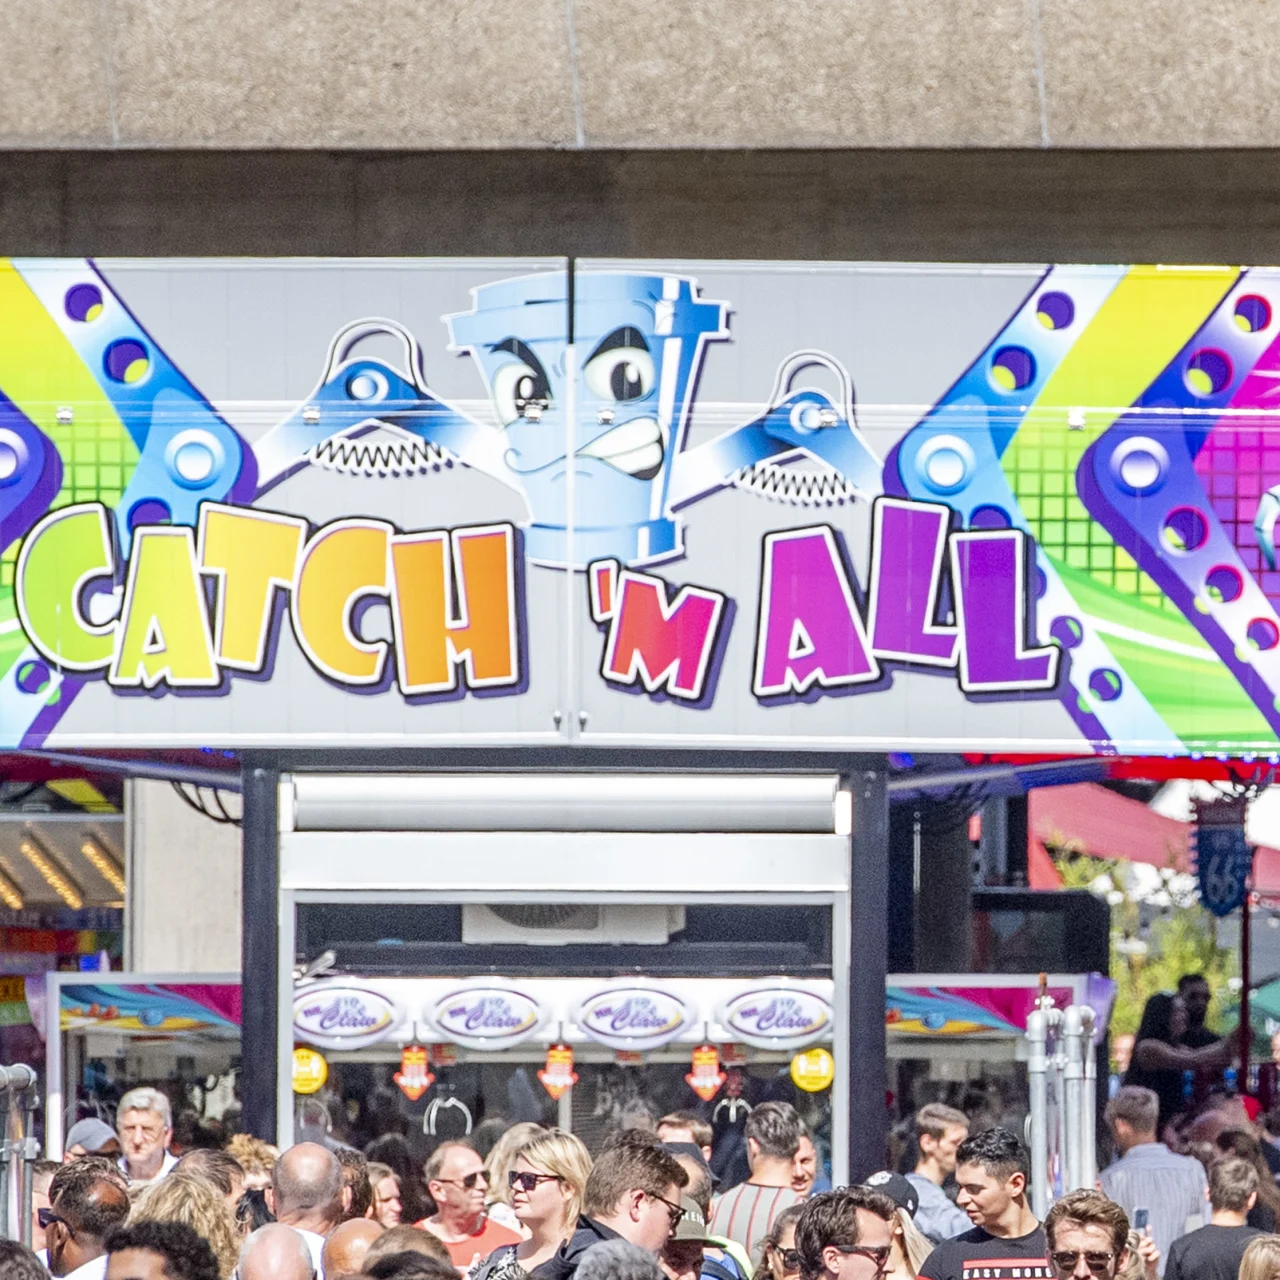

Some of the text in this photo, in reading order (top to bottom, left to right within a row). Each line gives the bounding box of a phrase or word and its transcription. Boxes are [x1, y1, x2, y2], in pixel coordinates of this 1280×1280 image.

[15, 496, 1064, 703] CATCH 'M ALL
[962, 1267, 1001, 1280] EASY
